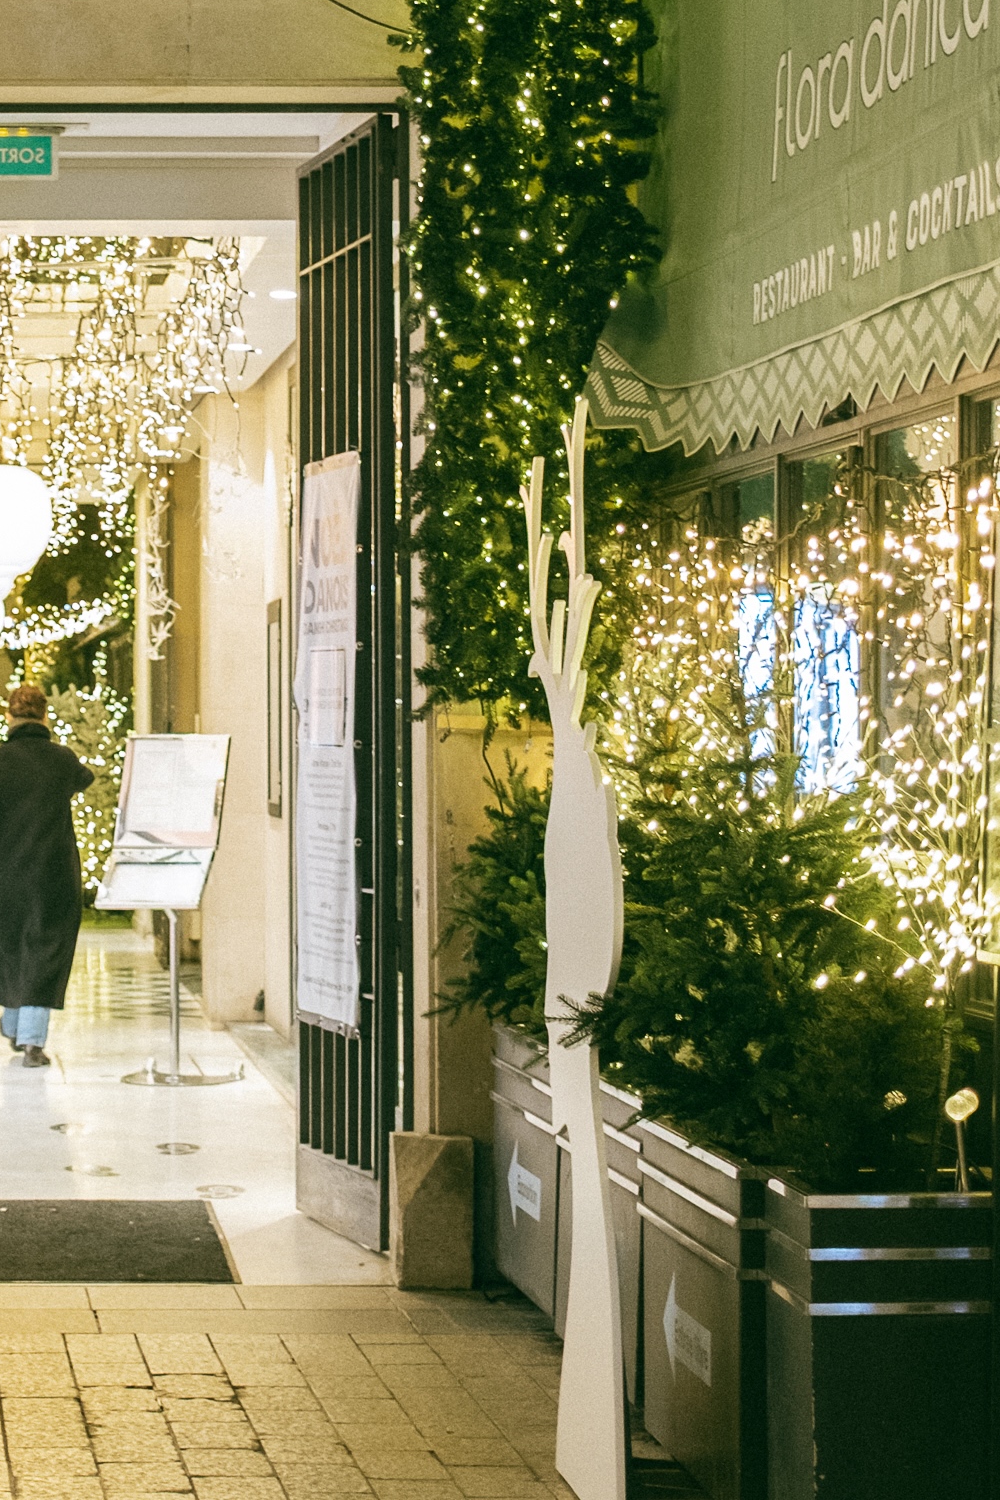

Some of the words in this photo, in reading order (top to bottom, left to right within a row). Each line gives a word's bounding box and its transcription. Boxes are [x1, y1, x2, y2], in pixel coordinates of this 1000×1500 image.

[771, 37, 854, 183] flora
[753, 244, 835, 325] RESTAURANT
[852, 220, 881, 279] BAR
[887, 210, 898, 260] &
